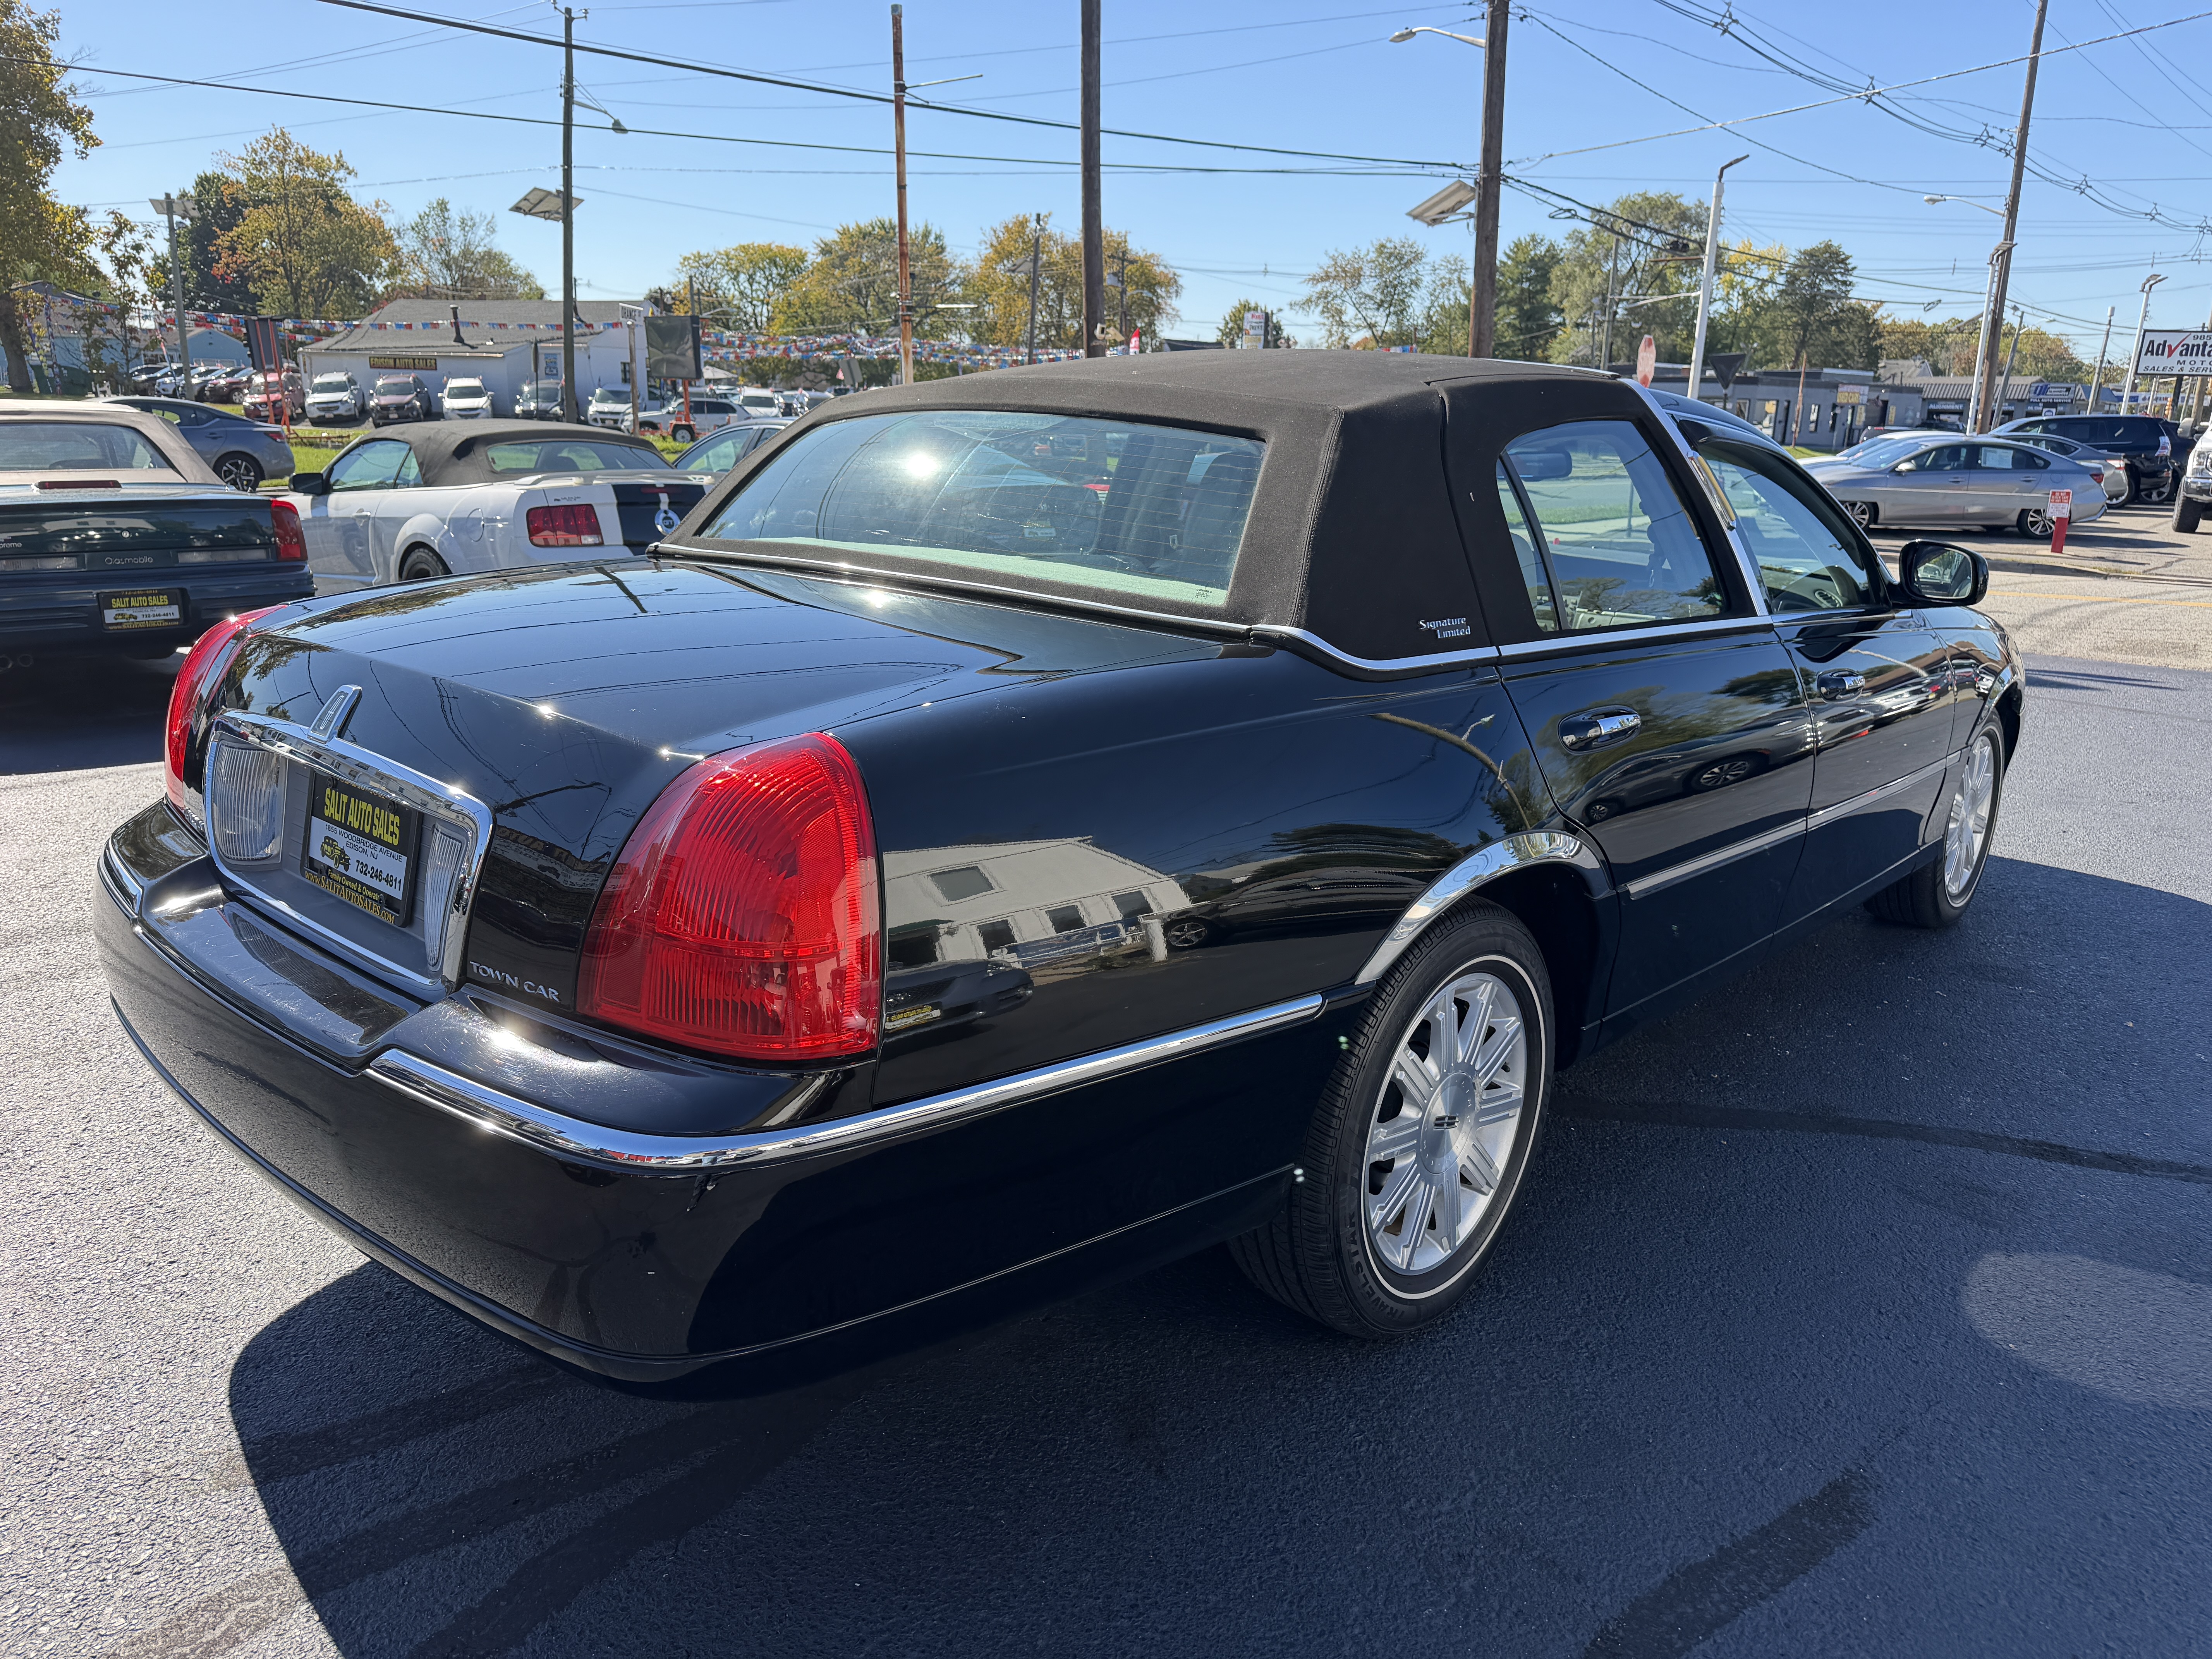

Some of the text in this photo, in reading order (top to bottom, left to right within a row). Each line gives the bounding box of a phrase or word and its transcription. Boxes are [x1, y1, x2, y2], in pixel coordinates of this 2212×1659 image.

[395, 358, 414, 369] AUTO
[414, 358, 436, 369] SALES
[105, 555, 153, 565] Oldsmobile
[112, 595, 168, 608] SALIT AUTO SALES
[1419, 617, 1466, 630] Signature
[1437, 625, 1470, 639] Limited
[325, 788, 348, 823] SALIT
[347, 797, 372, 833] AUTO
[373, 807, 400, 846] SALES
[325, 824, 402, 862] 1855 WOODBRIDGE AVENUE
[346, 841, 378, 860] EDISON, NJ
[356, 860, 402, 891] 732-246-4811
[342, 876, 357, 890] Owned
[357, 884, 361, 893] &
[362, 886, 380, 901] Operat
[470, 961, 561, 1003] TOWN CAR
[1345, 1211, 1405, 1318] TRAVELSTAR
